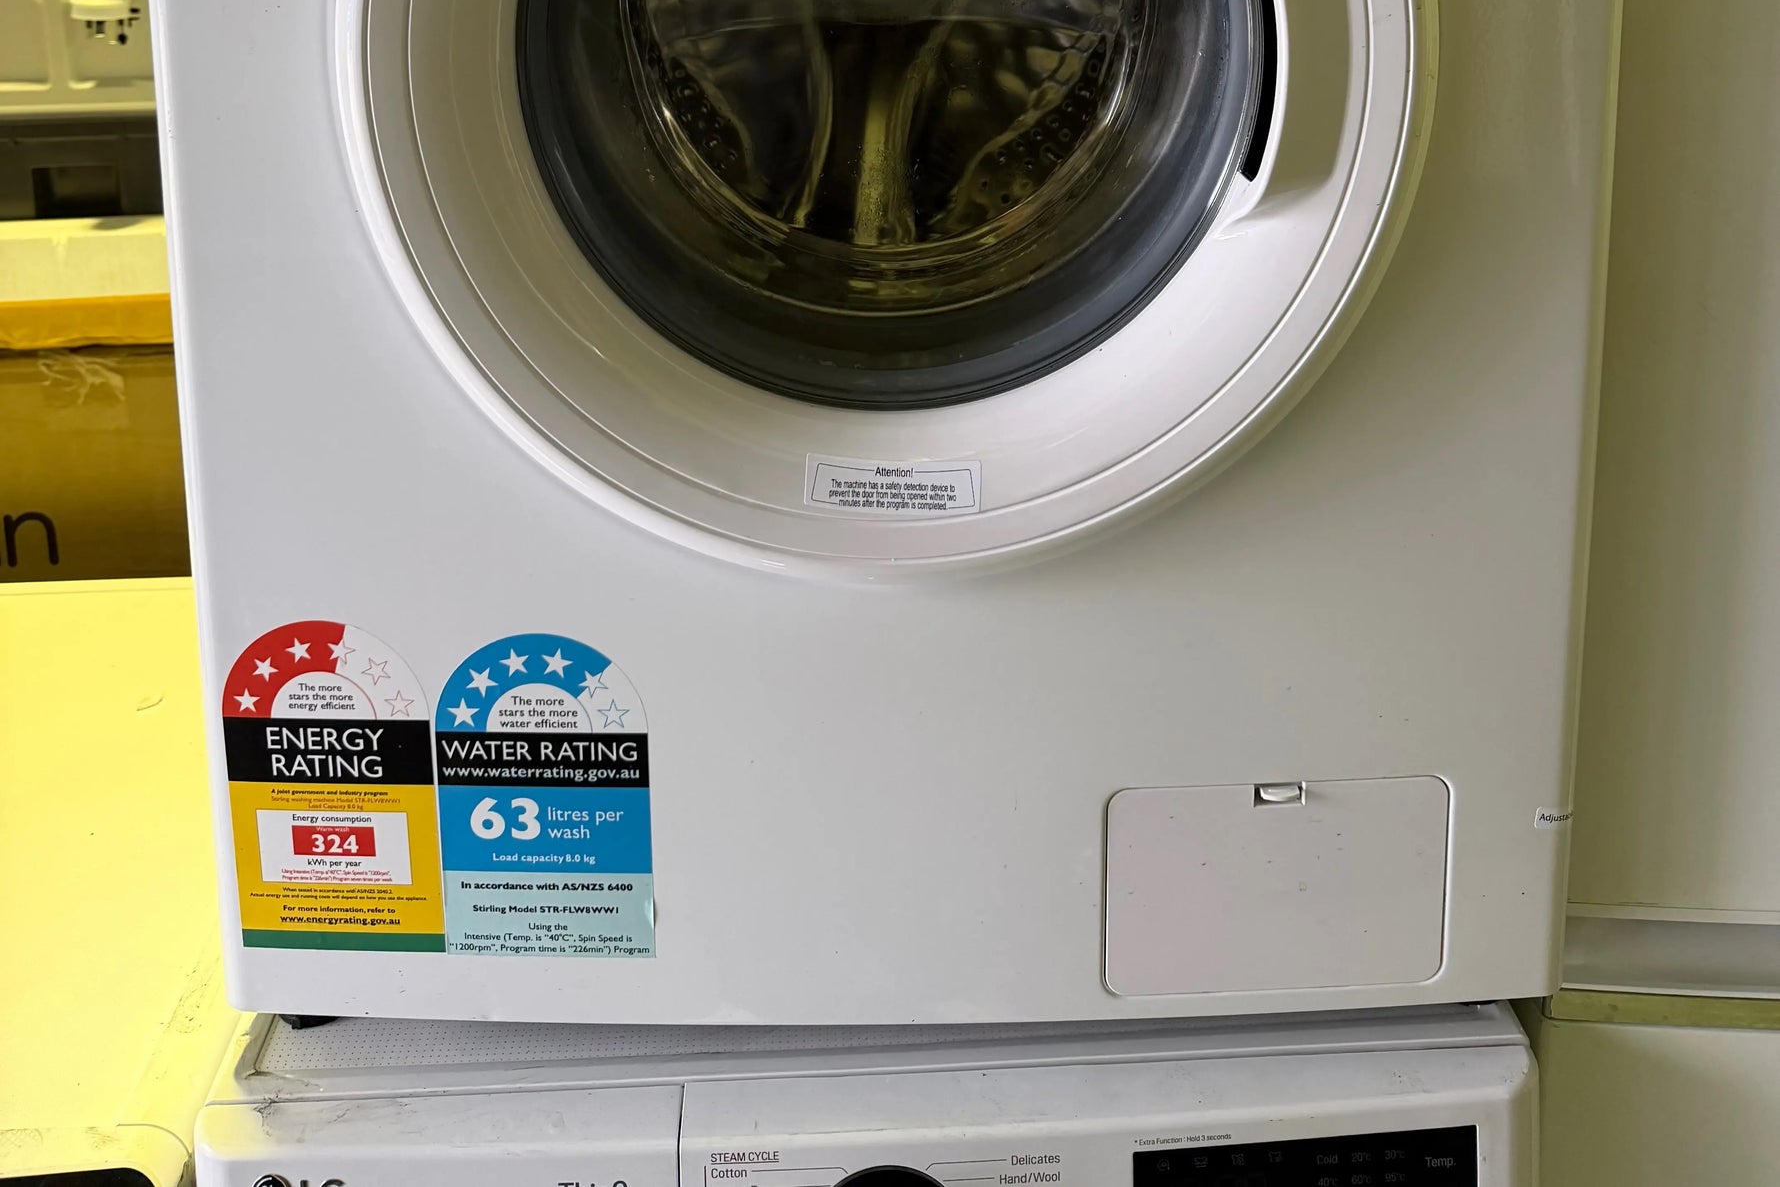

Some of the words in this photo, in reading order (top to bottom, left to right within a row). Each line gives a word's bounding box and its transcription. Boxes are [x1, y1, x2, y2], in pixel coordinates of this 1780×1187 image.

[874, 466, 913, 478] Attention!
[831, 478, 842, 488] The
[844, 480, 867, 490] machine
[868, 480, 879, 490] has
[885, 481, 902, 492] safety
[904, 482, 928, 492] detection
[930, 483, 948, 493] device
[950, 484, 955, 493] to
[829, 490, 850, 498] prevent
[852, 489, 860, 498] the
[862, 490, 875, 500] door
[876, 490, 888, 499] from
[890, 490, 905, 502] being
[906, 491, 927, 502] opened
[929, 492, 945, 501] within
[946, 493, 956, 502] two
[839, 499, 860, 507] minutes
[862, 500, 875, 508] after
[876, 500, 885, 508] the
[886, 501, 909, 511] program
[917, 502, 948, 511] completed.
[298, 683, 315, 692] The
[289, 694, 310, 702] stars
[312, 693, 326, 701] the
[511, 696, 532, 706] The
[536, 698, 564, 706] more
[289, 702, 318, 712] energy
[320, 701, 355, 710] efficient
[499, 708, 525, 718] stars
[528, 708, 546, 718] the
[549, 709, 578, 718] more
[500, 720, 531, 728] water
[534, 718, 578, 729] efficient
[266, 727, 384, 752] ENERGY
[442, 740, 532, 761] WATER
[540, 742, 638, 762] RATING
[271, 754, 383, 778] RATING
[442, 766, 640, 781] www.waterrating.gov.au
[292, 814, 318, 824] Energy
[321, 816, 372, 824] consumption
[470, 797, 541, 840] 63
[548, 806, 590, 822] litres
[596, 809, 624, 826] per
[548, 826, 590, 839] wash
[312, 834, 359, 854] 324
[307, 858, 327, 866] kWh
[492, 853, 518, 862] Load
[520, 853, 564, 865] capacity
[565, 854, 581, 863] 8.0
[583, 853, 596, 865] kg
[461, 881, 472, 890] In
[474, 882, 534, 890] accordance
[536, 883, 559, 891] with
[562, 883, 604, 891] AS/NZS
[607, 883, 633, 891] 6400
[473, 904, 506, 914] Stirling
[508, 905, 537, 913] Model
[280, 916, 400, 926] www.energyrating.gov.au
[529, 922, 552, 932] Using
[464, 932, 501, 940] Intensive
[503, 933, 533, 942] (Temp.
[578, 934, 596, 944] Spin
[598, 934, 624, 944] Speed
[500, 943, 536, 953] Program
[614, 946, 650, 955] Program
[1156, 1136, 1183, 1144] Function
[711, 1152, 746, 1162] STEAM
[748, 1151, 780, 1161] CYCLE
[1011, 1154, 1060, 1166] Delicates
[1317, 1154, 1338, 1164] Cold
[1425, 1156, 1456, 1168] Temp.
[711, 1168, 748, 1179] Cotton
[1000, 1171, 1060, 1185] Hand/Wool
